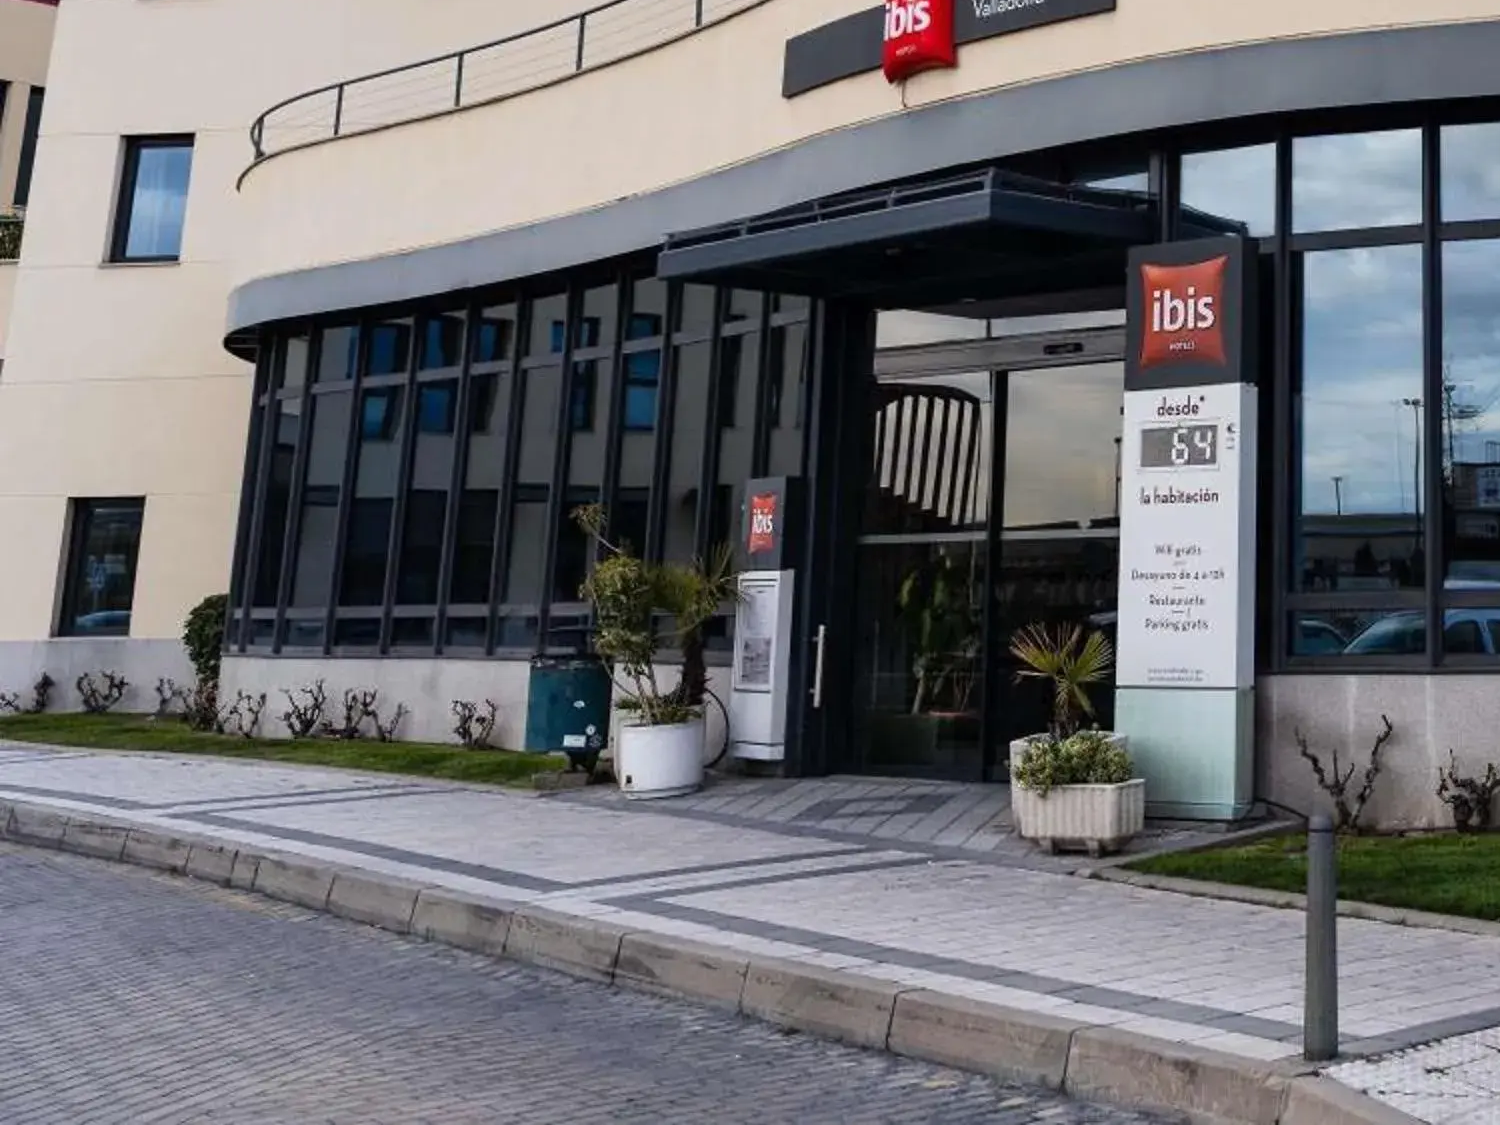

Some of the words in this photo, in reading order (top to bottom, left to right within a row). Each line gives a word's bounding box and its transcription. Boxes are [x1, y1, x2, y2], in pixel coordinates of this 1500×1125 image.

[1152, 285, 1215, 332] ibis
[1171, 428, 1212, 465] 64
[1153, 485, 1219, 504] habitación
